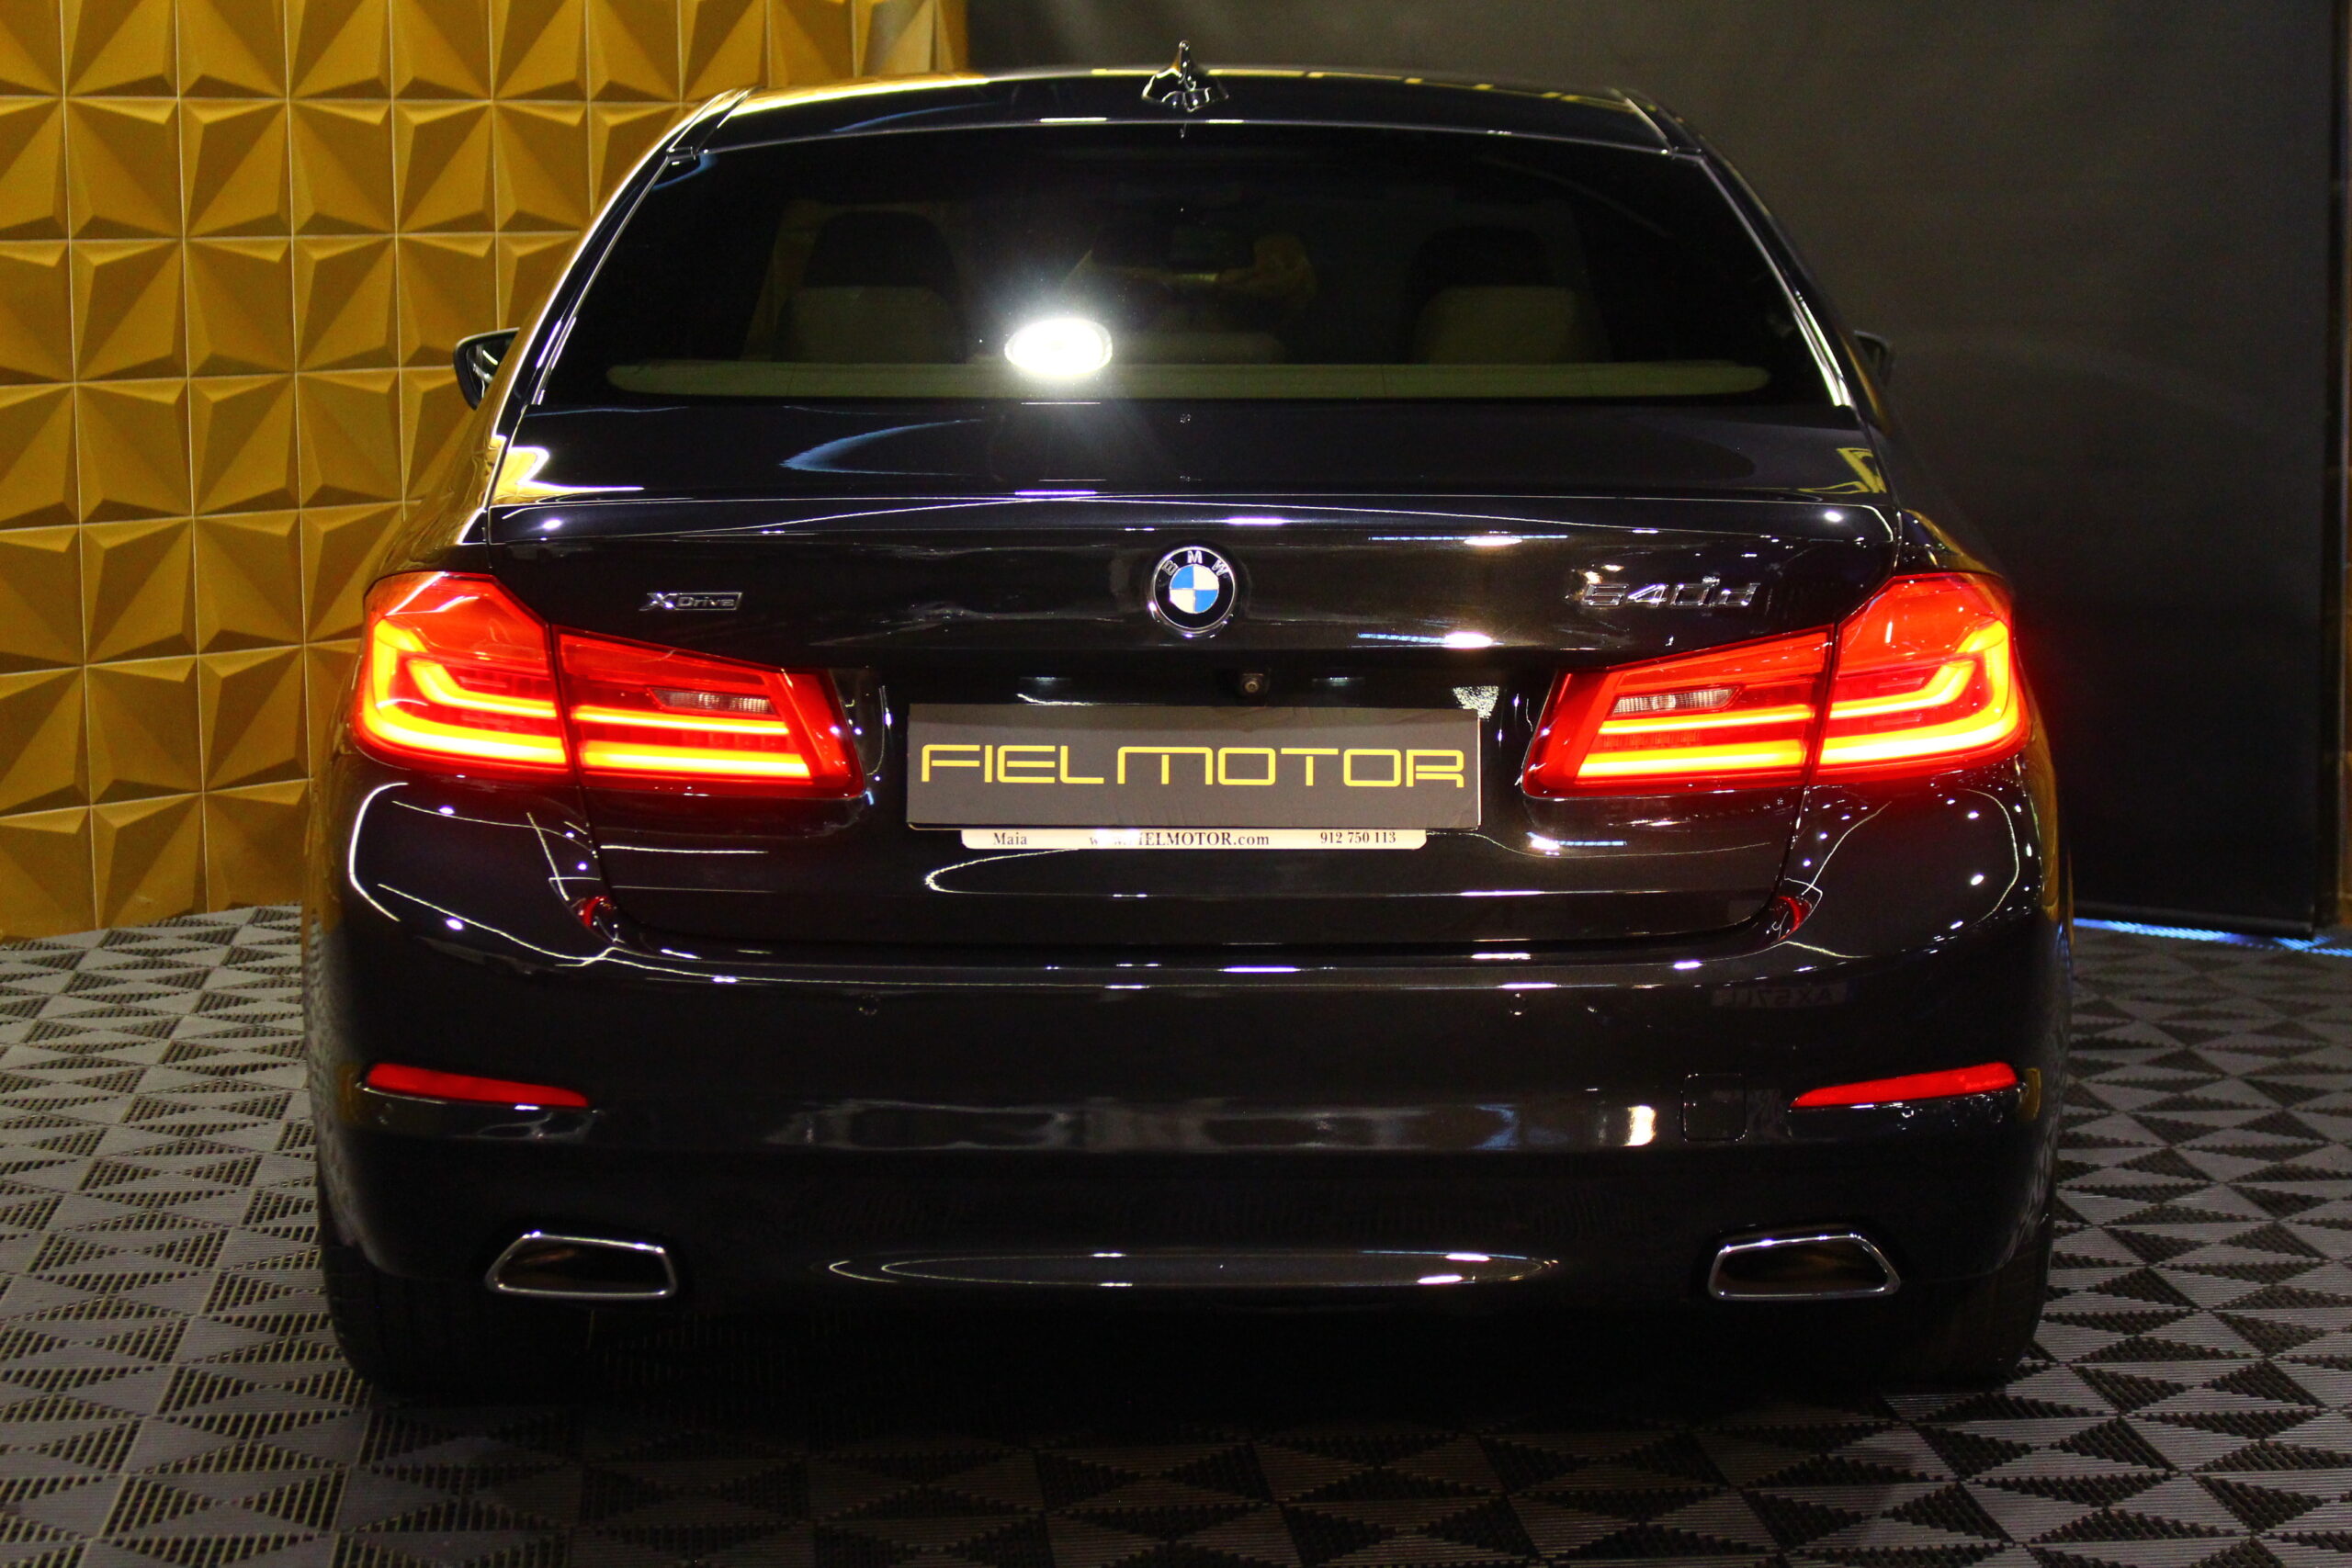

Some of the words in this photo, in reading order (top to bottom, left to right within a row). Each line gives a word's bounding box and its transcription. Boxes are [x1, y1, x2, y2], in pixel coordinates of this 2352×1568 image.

[1161, 549, 1232, 577] BMW
[992, 831, 1028, 845] Maia
[1319, 831, 1342, 843] 912
[1347, 831, 1370, 843] 750
[1374, 831, 1396, 843] 113
